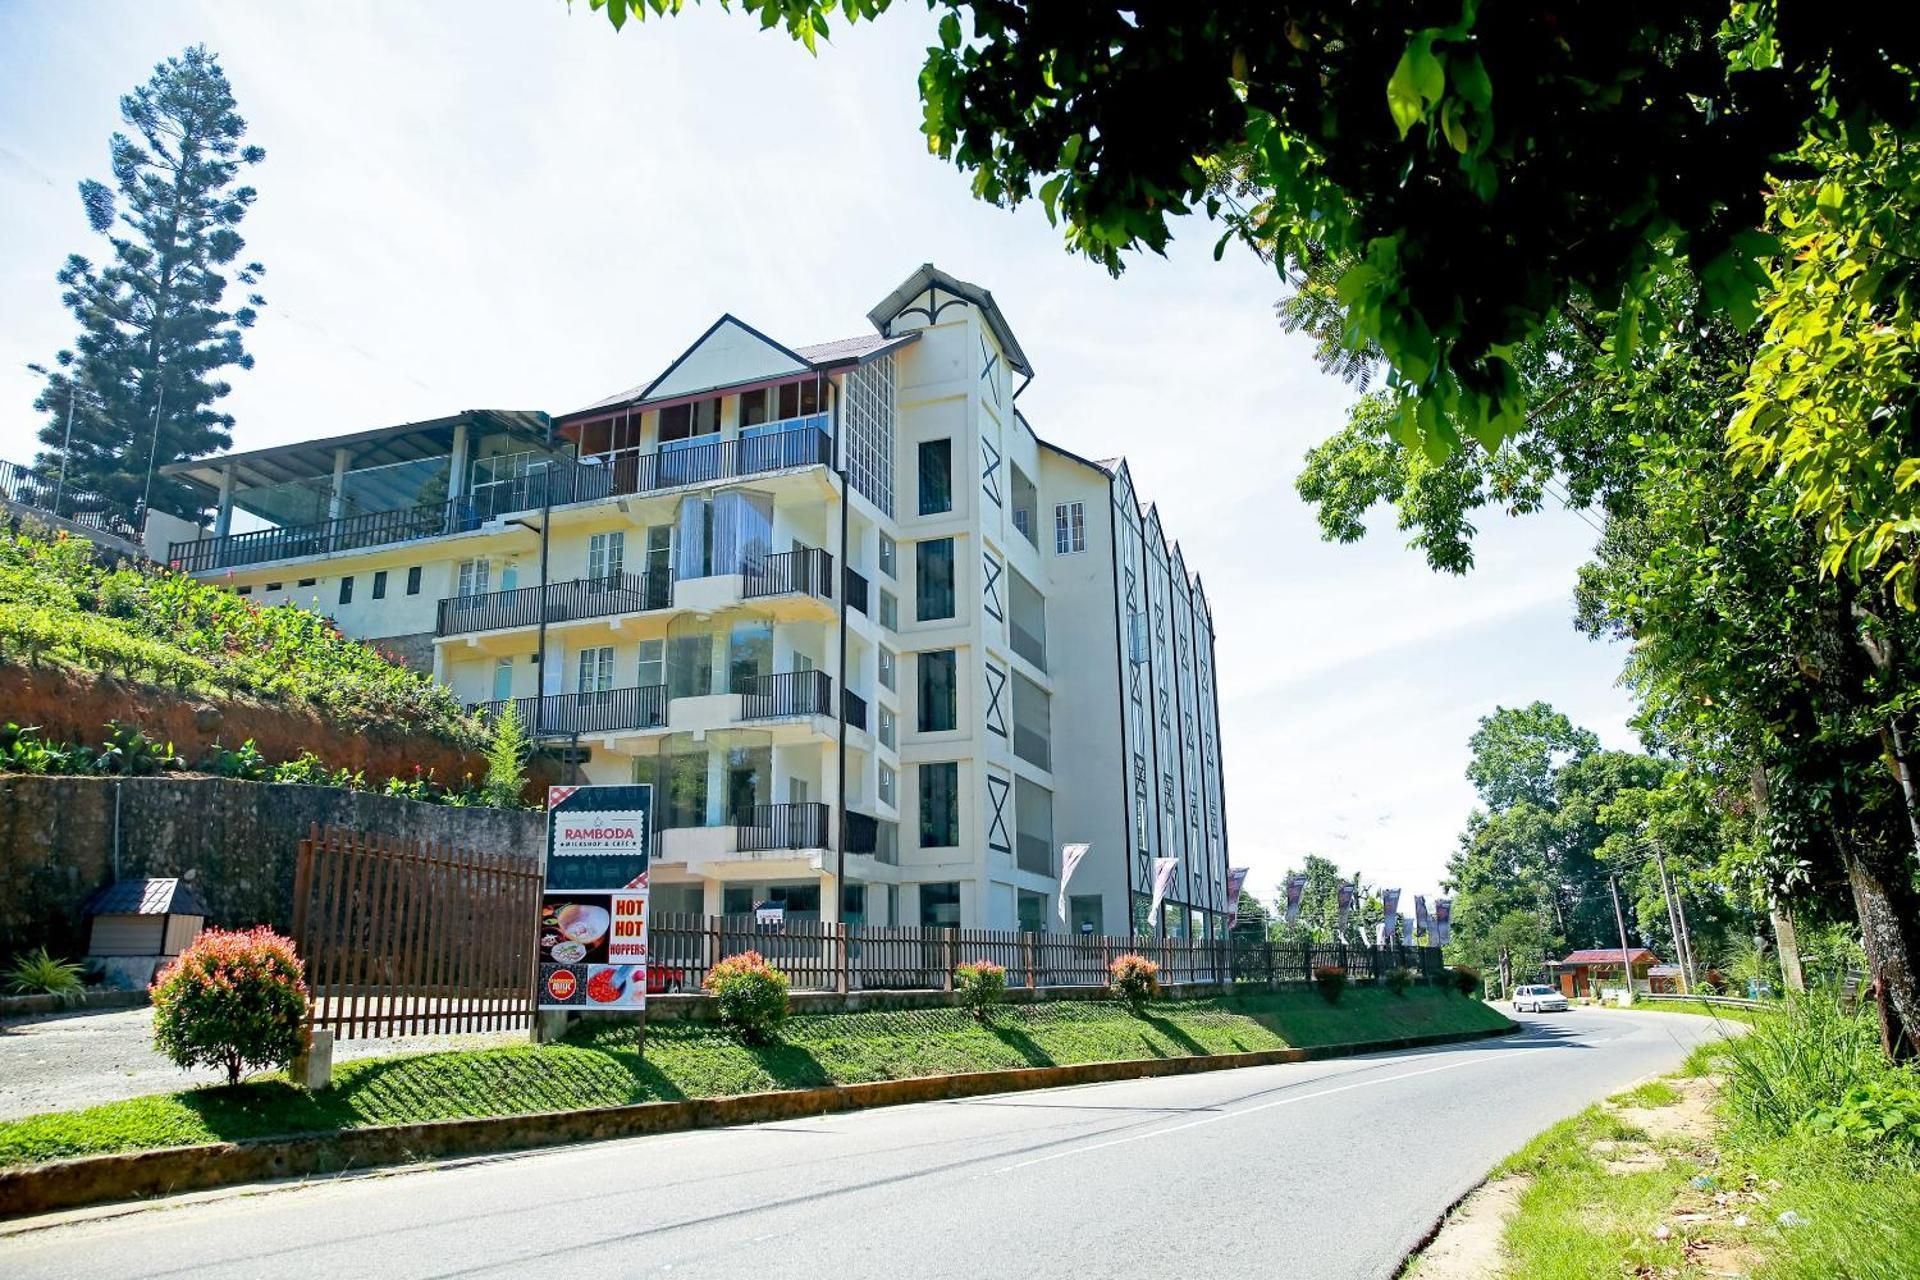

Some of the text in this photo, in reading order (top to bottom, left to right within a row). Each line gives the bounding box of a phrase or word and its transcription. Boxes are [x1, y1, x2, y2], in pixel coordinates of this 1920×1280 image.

[565, 828, 634, 840] RAMBODA
[616, 900, 644, 916] HOT
[615, 921, 643, 936] HOT
[610, 943, 645, 956] HOPPERS
